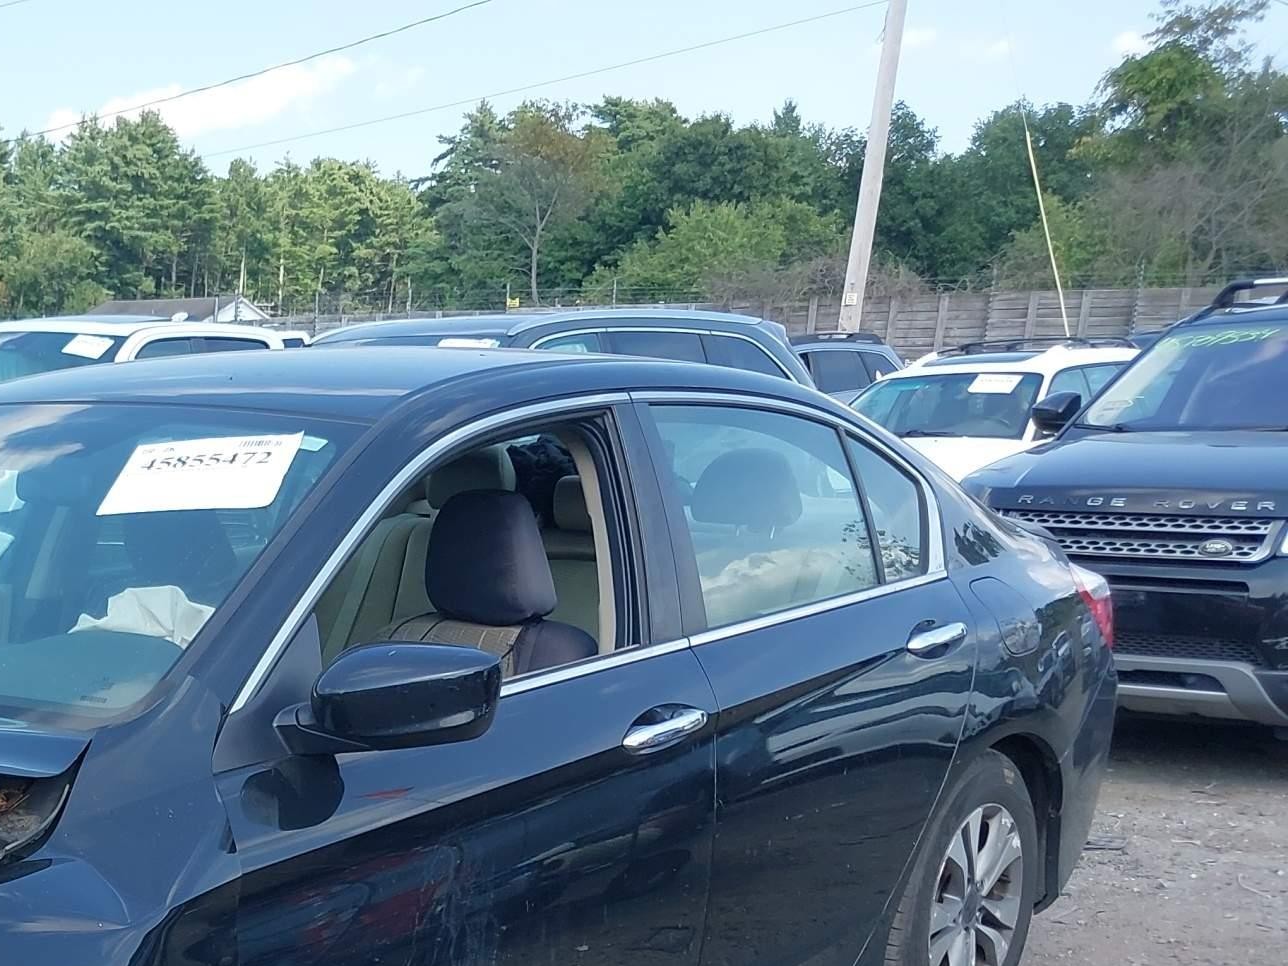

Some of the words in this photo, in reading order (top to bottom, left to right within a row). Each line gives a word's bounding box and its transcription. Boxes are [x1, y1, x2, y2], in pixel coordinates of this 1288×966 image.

[141, 451, 272, 470] 45855472
[1018, 494, 1127, 507] RANGE
[1154, 499, 1276, 511] ROVER
